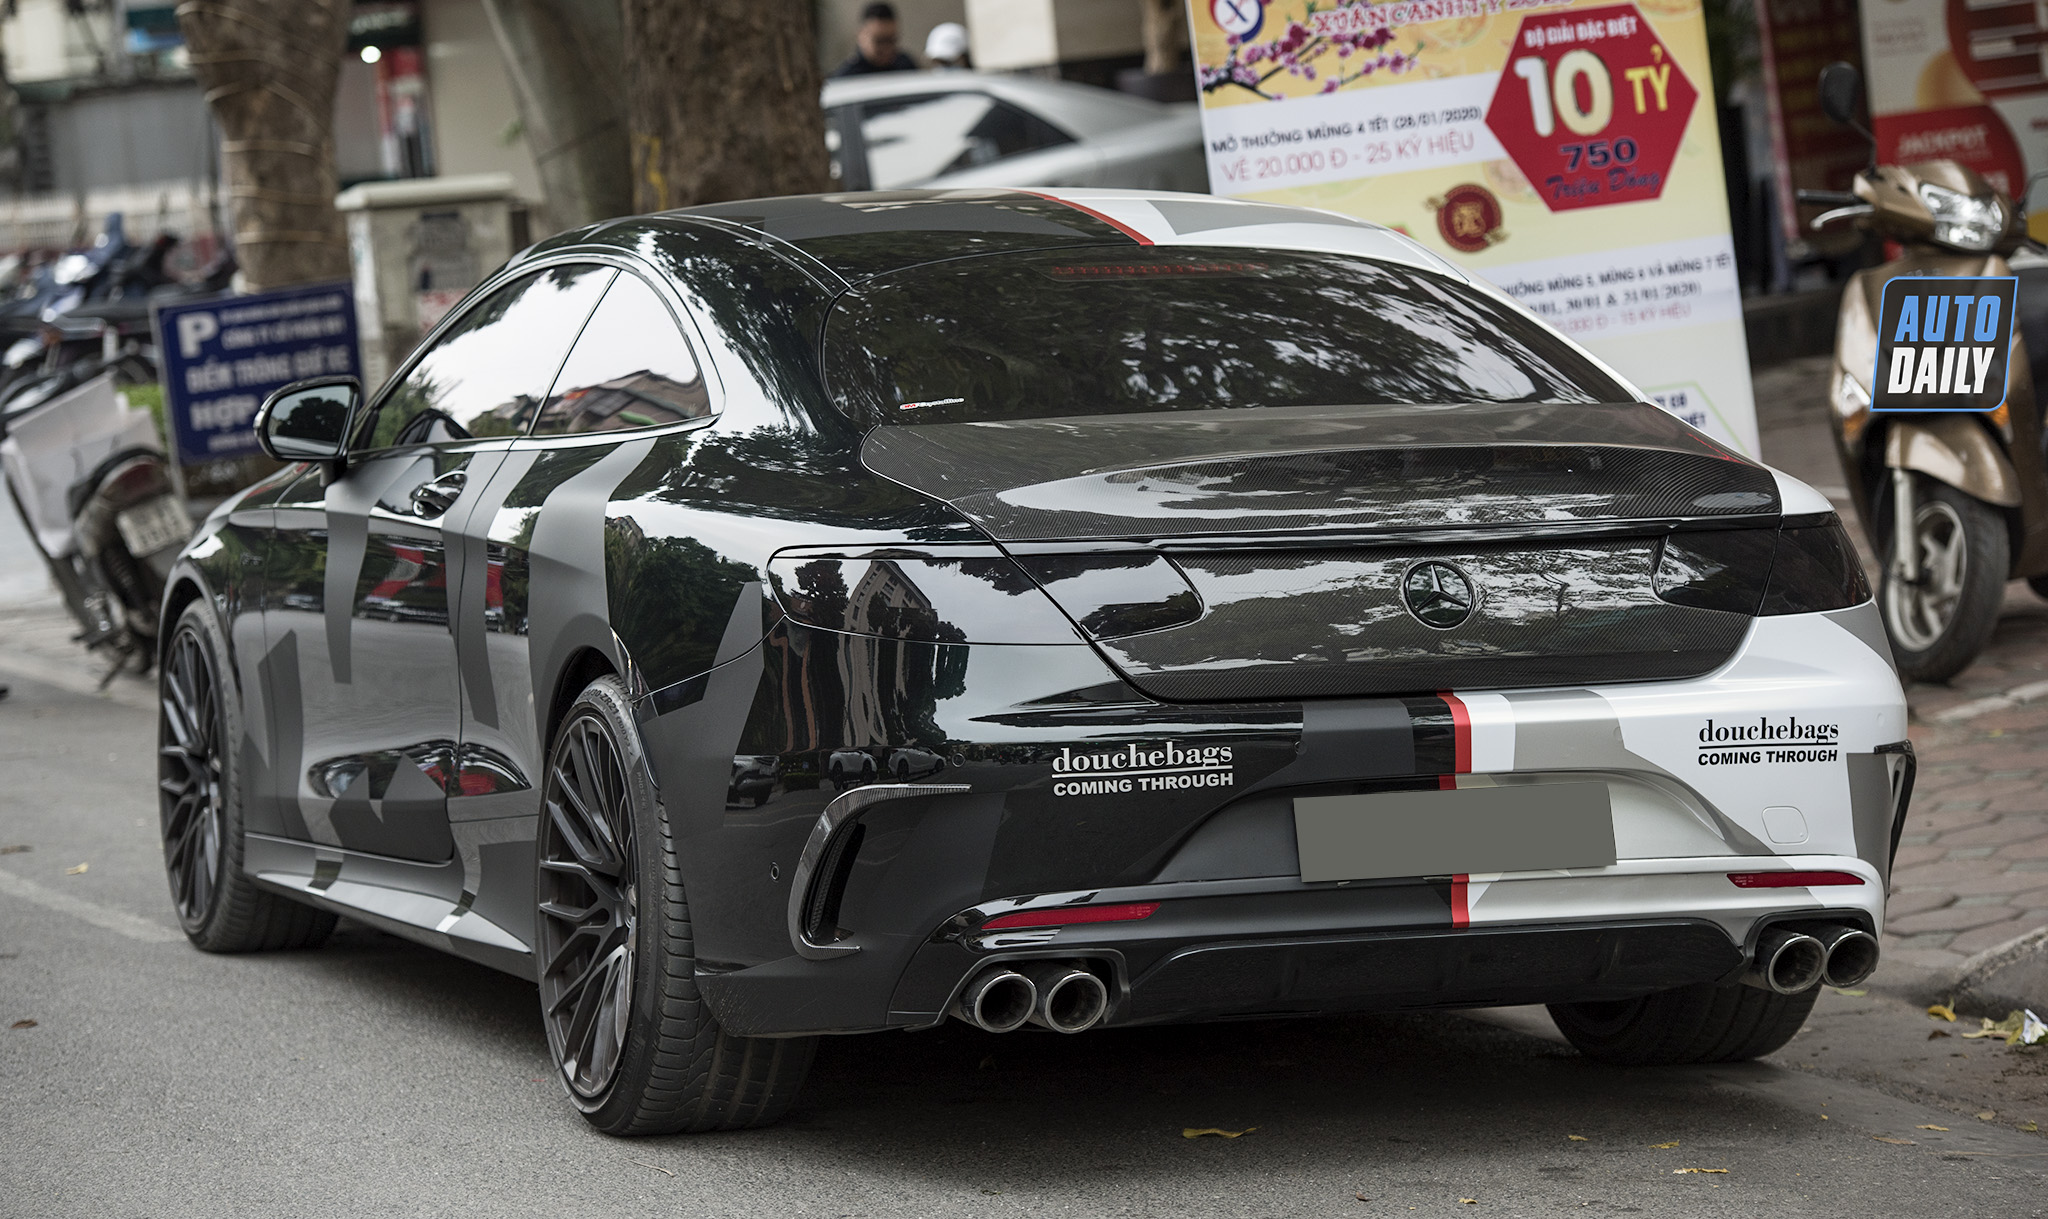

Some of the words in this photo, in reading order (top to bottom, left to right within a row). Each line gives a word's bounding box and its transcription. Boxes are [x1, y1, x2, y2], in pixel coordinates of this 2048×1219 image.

[1524, 26, 1545, 49] BỘ
[1546, 19, 1575, 45] GIẢI
[1607, 15, 1638, 39] BIỆT
[1514, 48, 1614, 137] 10
[1625, 44, 1671, 114] TỶ
[1256, 153, 1325, 179] 20.000
[1366, 142, 1394, 165] 25
[1559, 137, 1639, 173] 750
[177, 311, 218, 359] P
[1699, 716, 1839, 744] douchebags
[1052, 742, 1233, 772] douchebags
[1698, 751, 1761, 766] COMING
[1766, 749, 1838, 763] THROUGH
[1053, 778, 1132, 797] COMING
[1138, 772, 1234, 791] THROUGH
